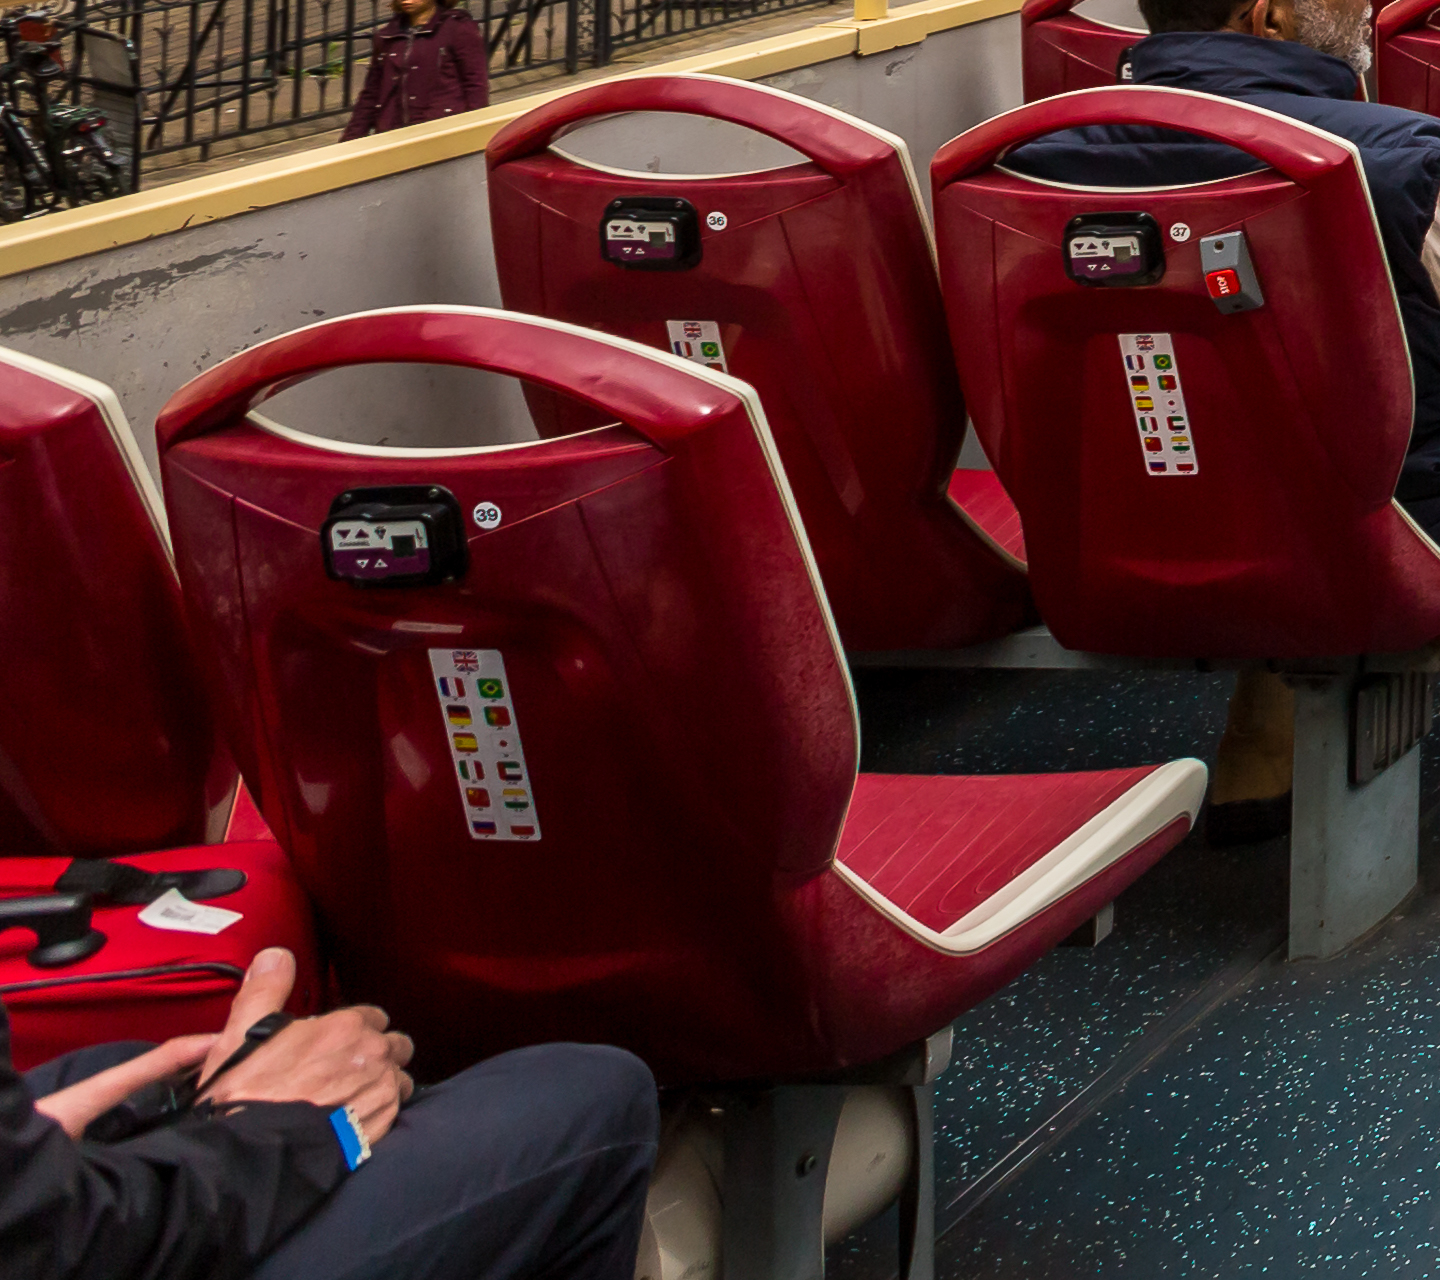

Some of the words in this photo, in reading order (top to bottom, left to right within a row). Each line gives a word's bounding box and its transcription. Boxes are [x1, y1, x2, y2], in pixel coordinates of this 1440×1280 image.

[708, 215, 725, 226] 36
[1172, 226, 1188, 237] 37
[475, 508, 499, 523] 39
